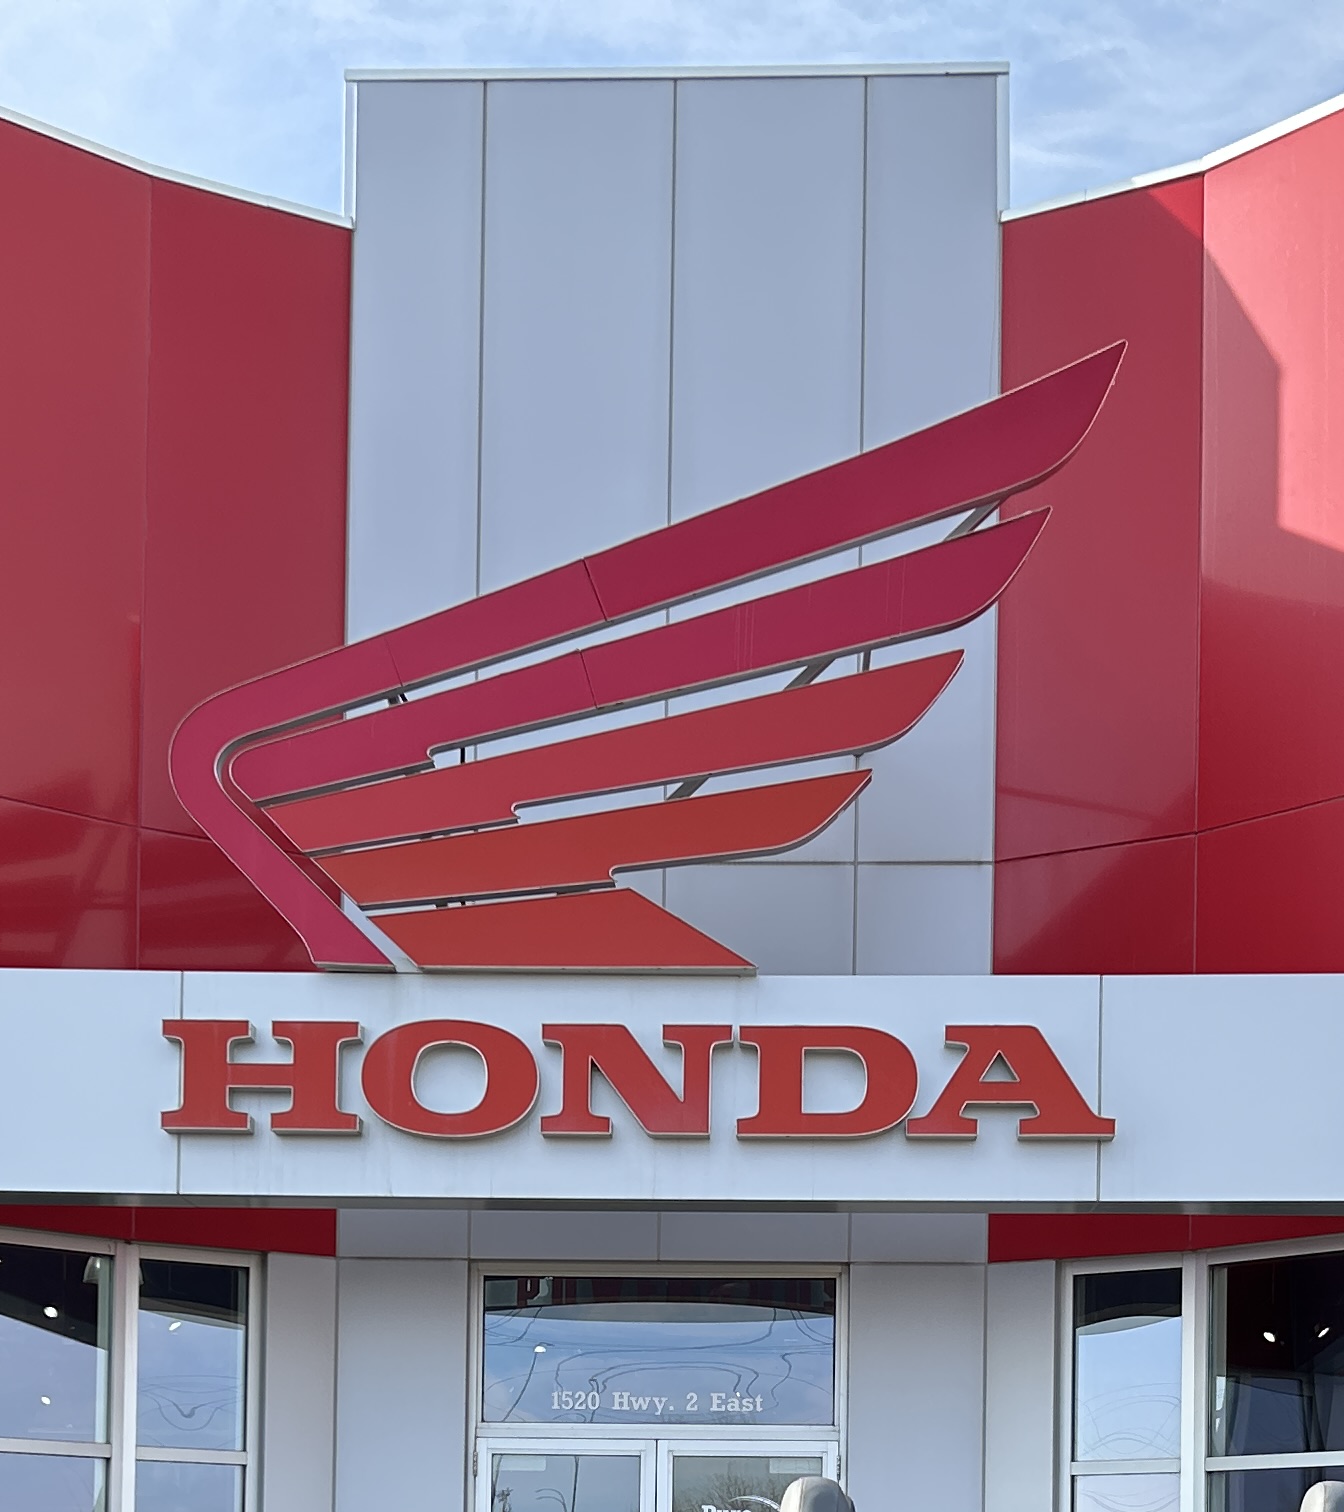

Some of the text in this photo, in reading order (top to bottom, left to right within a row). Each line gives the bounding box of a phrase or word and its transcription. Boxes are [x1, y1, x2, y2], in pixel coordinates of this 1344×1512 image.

[161, 1019, 1116, 1141] HONDA
[551, 1391, 764, 1415] 1520 Hwy. 2 East
